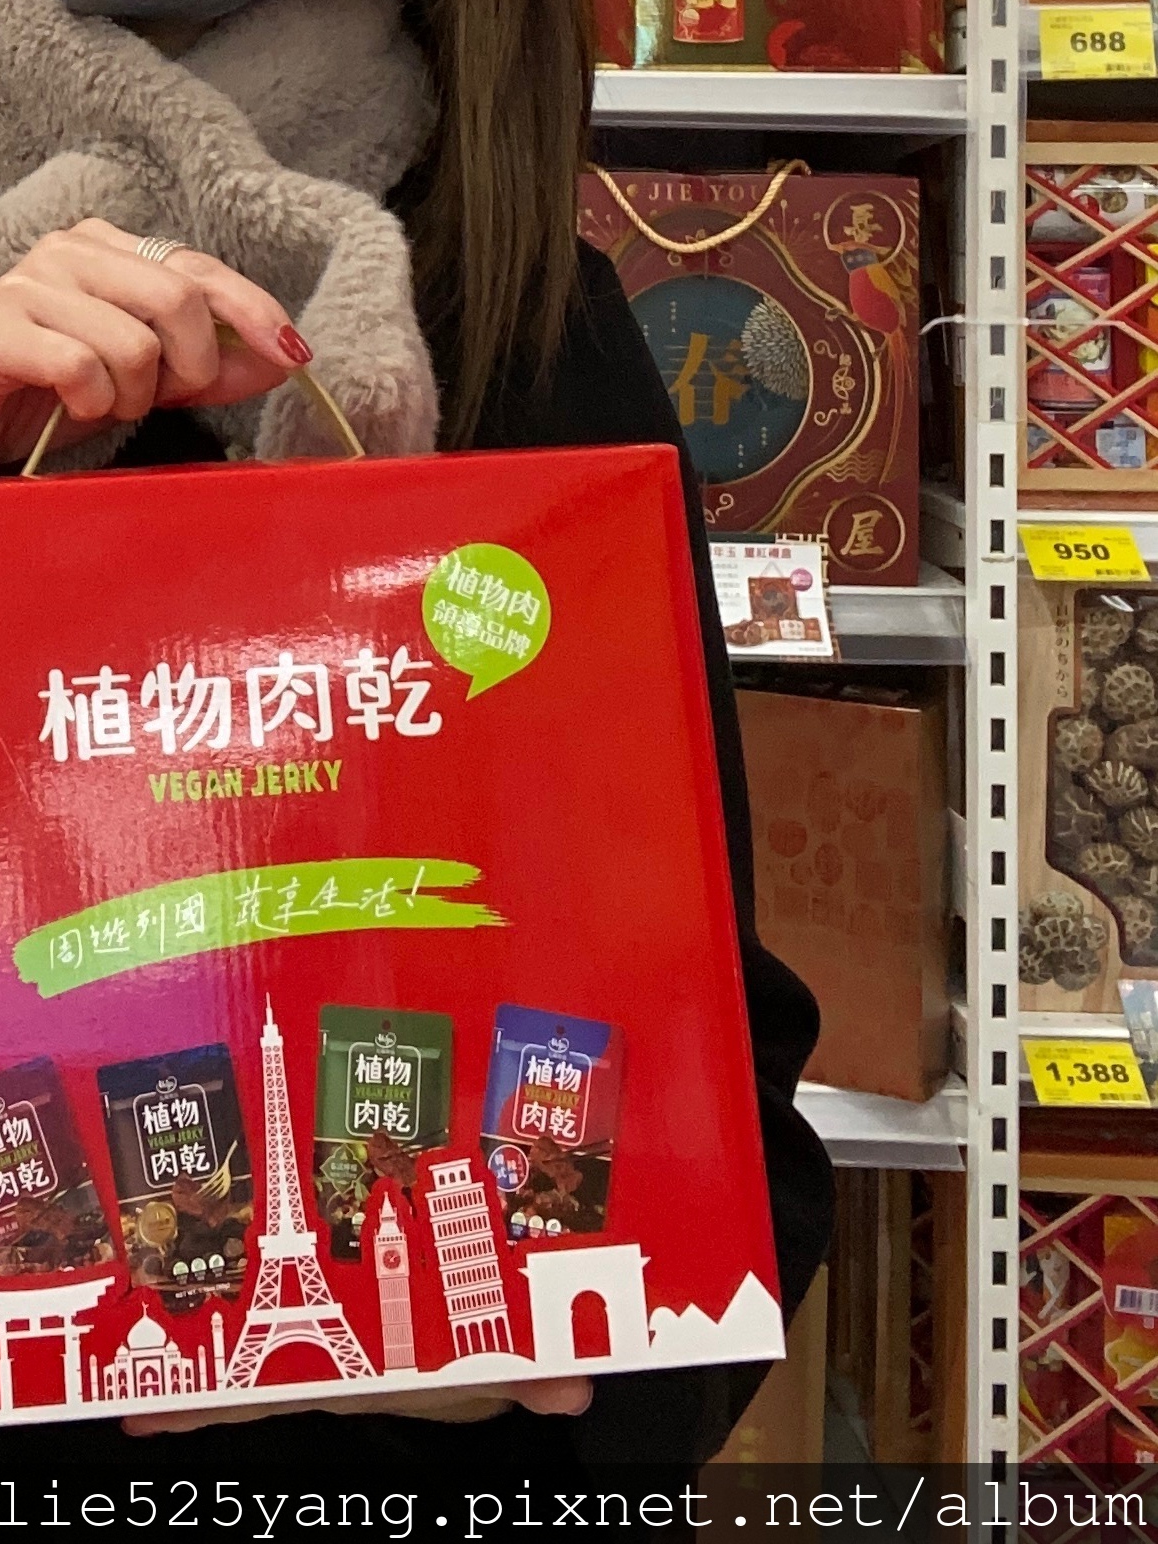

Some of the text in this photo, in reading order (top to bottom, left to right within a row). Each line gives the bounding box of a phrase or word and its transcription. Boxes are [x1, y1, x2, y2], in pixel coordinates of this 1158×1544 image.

[1069, 31, 1126, 53] 688
[648, 182, 692, 202] JIE
[838, 509, 886, 559] 屋
[1053, 543, 1110, 562] 950
[446, 558, 541, 626] 植物肉
[36, 645, 443, 764] 植物肉乾
[148, 759, 344, 804] VEGAN JERKY
[355, 1053, 411, 1086] 植物
[525, 1054, 582, 1093] 植物
[1045, 1061, 1130, 1089] 1,388
[141, 1097, 200, 1136] 植物
[354, 1099, 412, 1133] 肉乾
[520, 1101, 578, 1140] 肉乾
[150, 1141, 211, 1182] 肉乾
